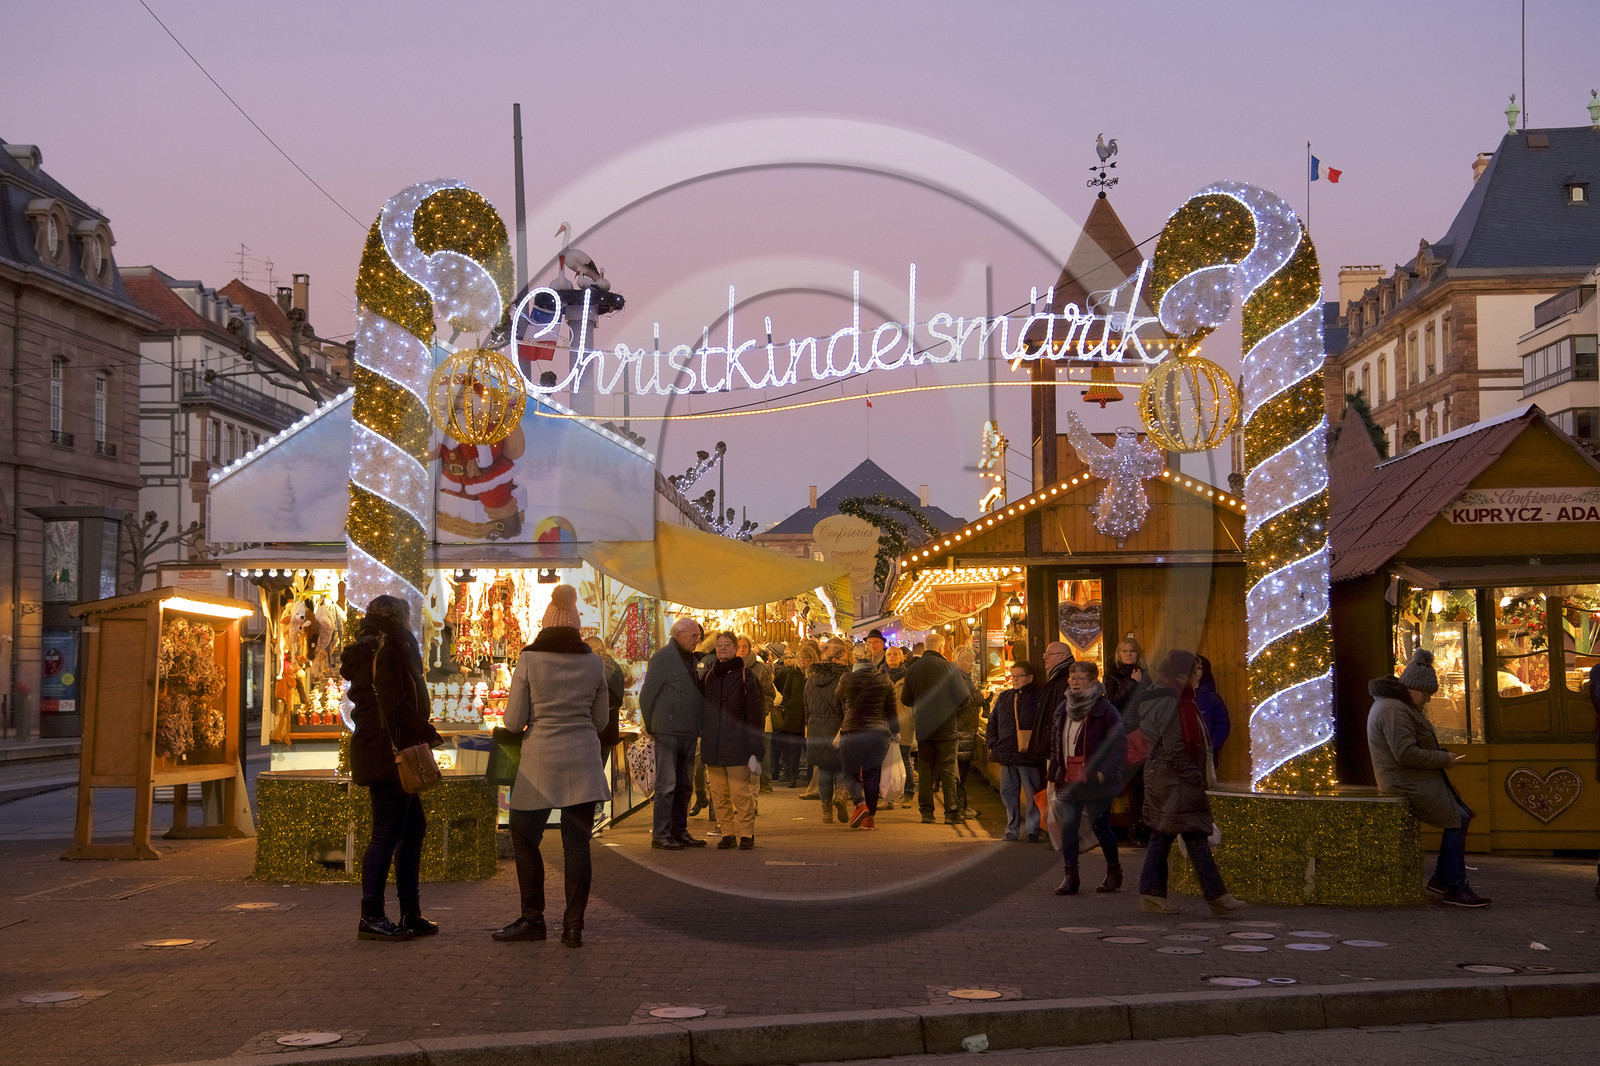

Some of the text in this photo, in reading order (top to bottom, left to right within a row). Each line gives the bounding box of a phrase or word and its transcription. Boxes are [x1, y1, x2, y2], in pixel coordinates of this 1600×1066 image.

[511, 259, 1169, 394] Christkindelsmärik
[1494, 489, 1574, 508] Confiserie
[1453, 507, 1543, 523] KUPRYCZ
[819, 524, 874, 544] Confiseries
[935, 589, 994, 606] Pommes d'amour
